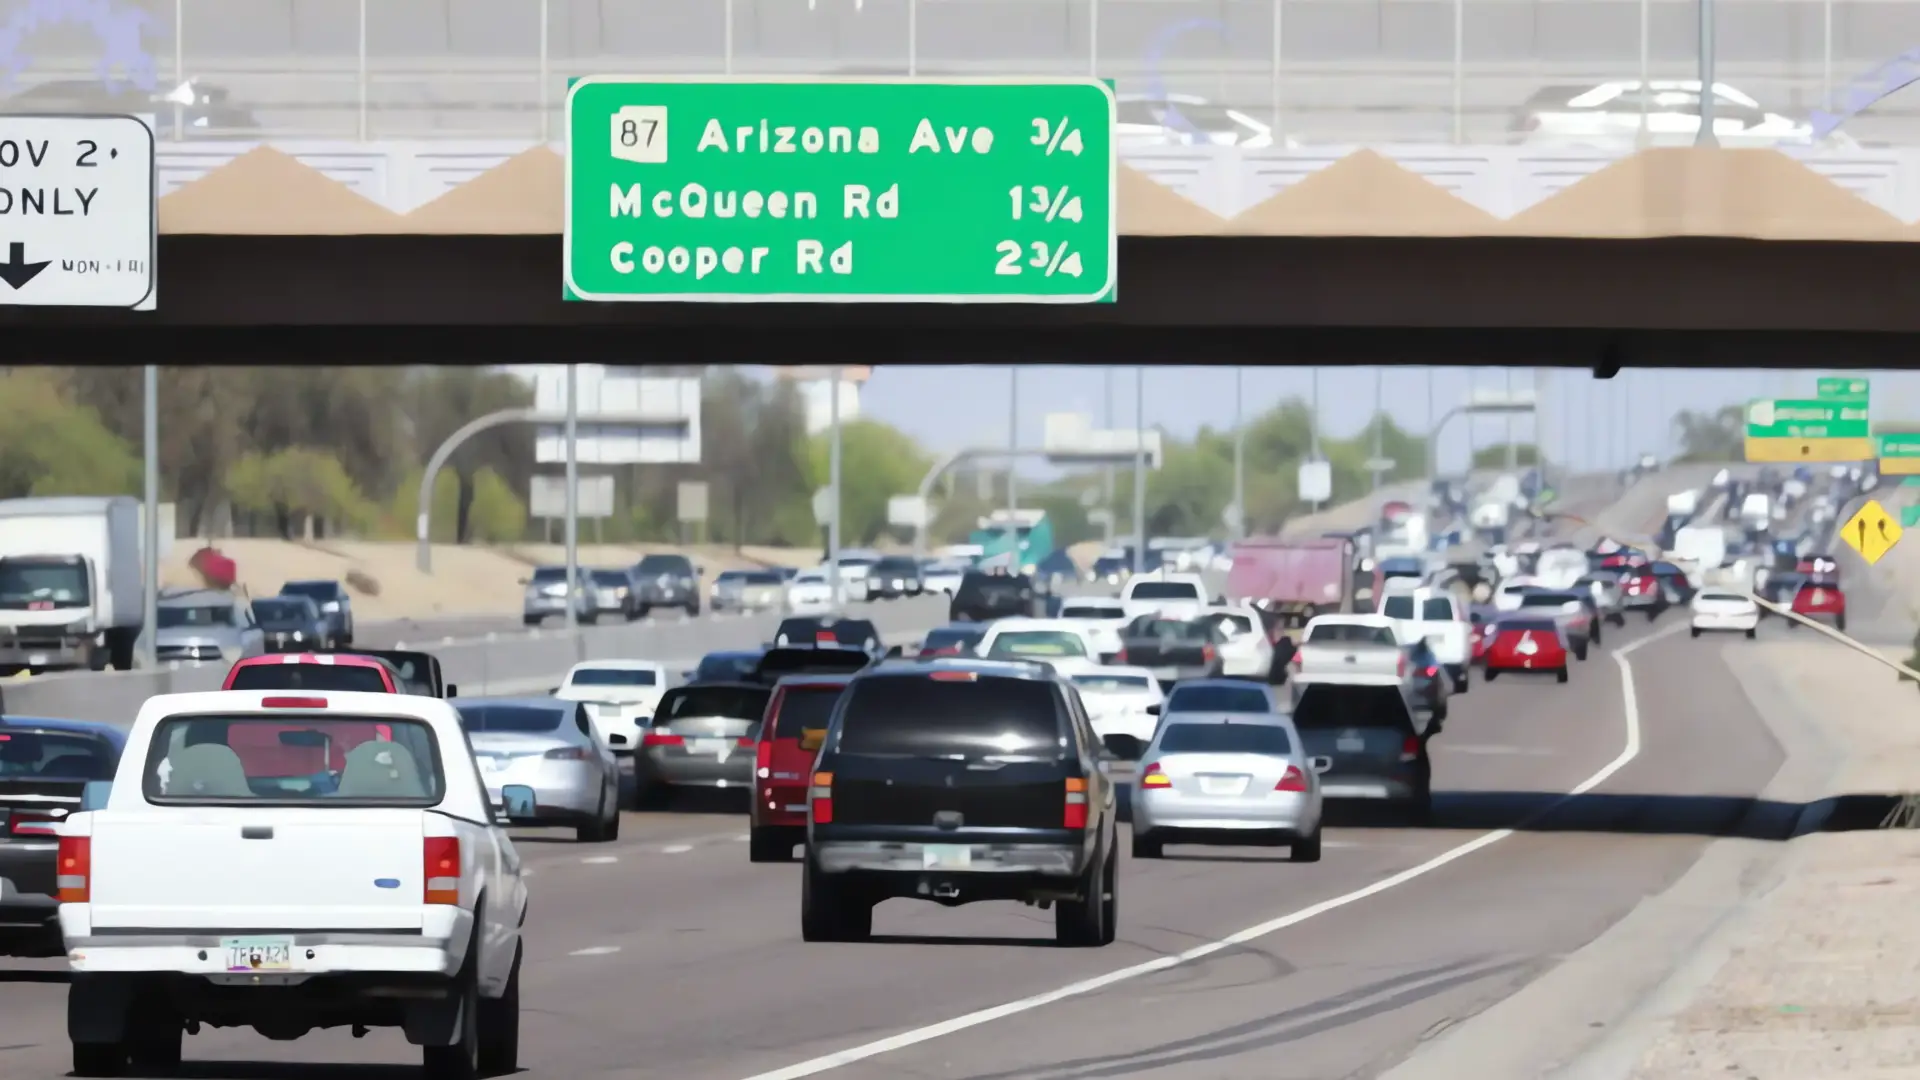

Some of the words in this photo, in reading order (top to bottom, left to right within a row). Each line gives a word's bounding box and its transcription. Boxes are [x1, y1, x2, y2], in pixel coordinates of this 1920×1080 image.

[619, 119, 659, 148] 87
[697, 118, 880, 154] Arizona
[908, 118, 994, 154] Ave
[610, 182, 817, 219] McQueen
[843, 183, 900, 219] Rd
[610, 241, 769, 280] Cooper
[796, 239, 853, 275] Rd
